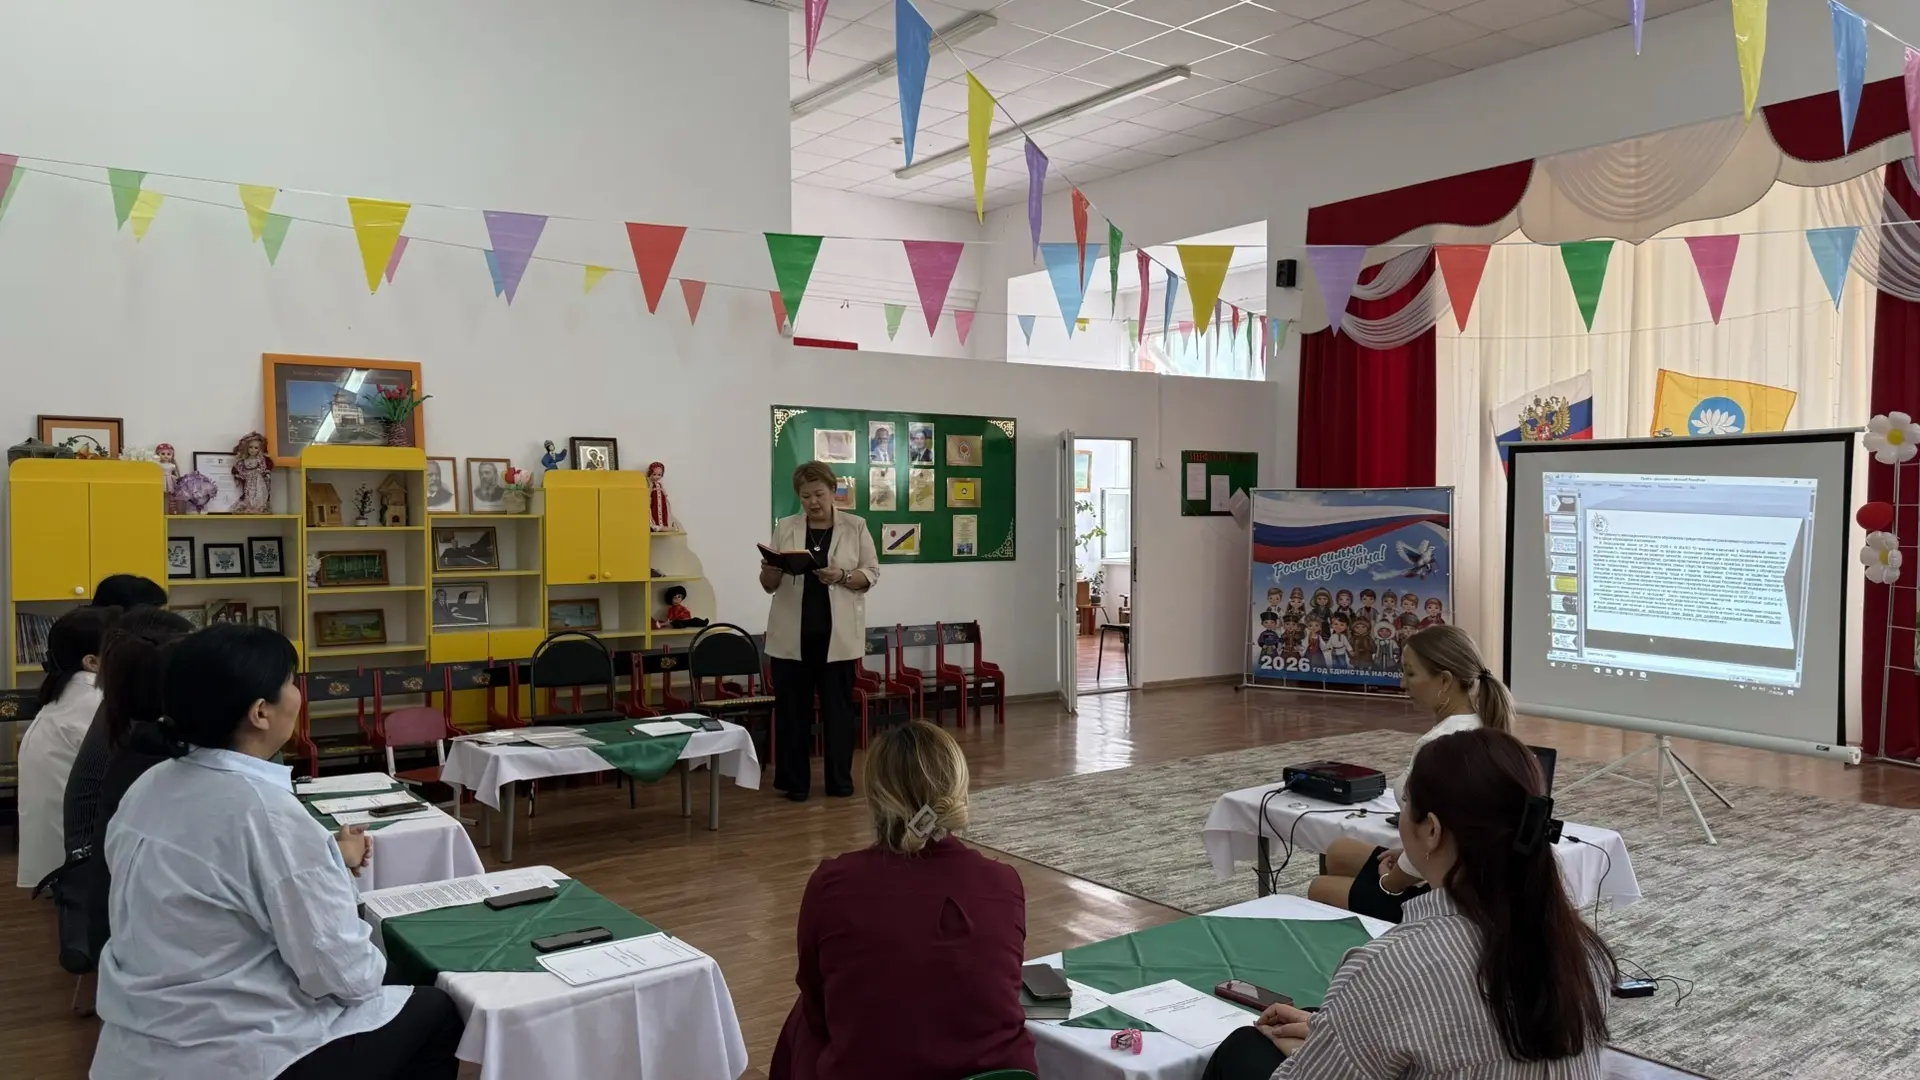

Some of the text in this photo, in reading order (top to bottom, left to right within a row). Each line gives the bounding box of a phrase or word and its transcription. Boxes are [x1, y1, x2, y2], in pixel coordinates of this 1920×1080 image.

[1273, 544, 1367, 577] Россия сильна,
[1306, 544, 1387, 581] когда едина!
[1260, 655, 1311, 673] 2026
[1329, 668, 1370, 677] ЕДИНСТВА
[1371, 671, 1404, 679] НАРОДО
